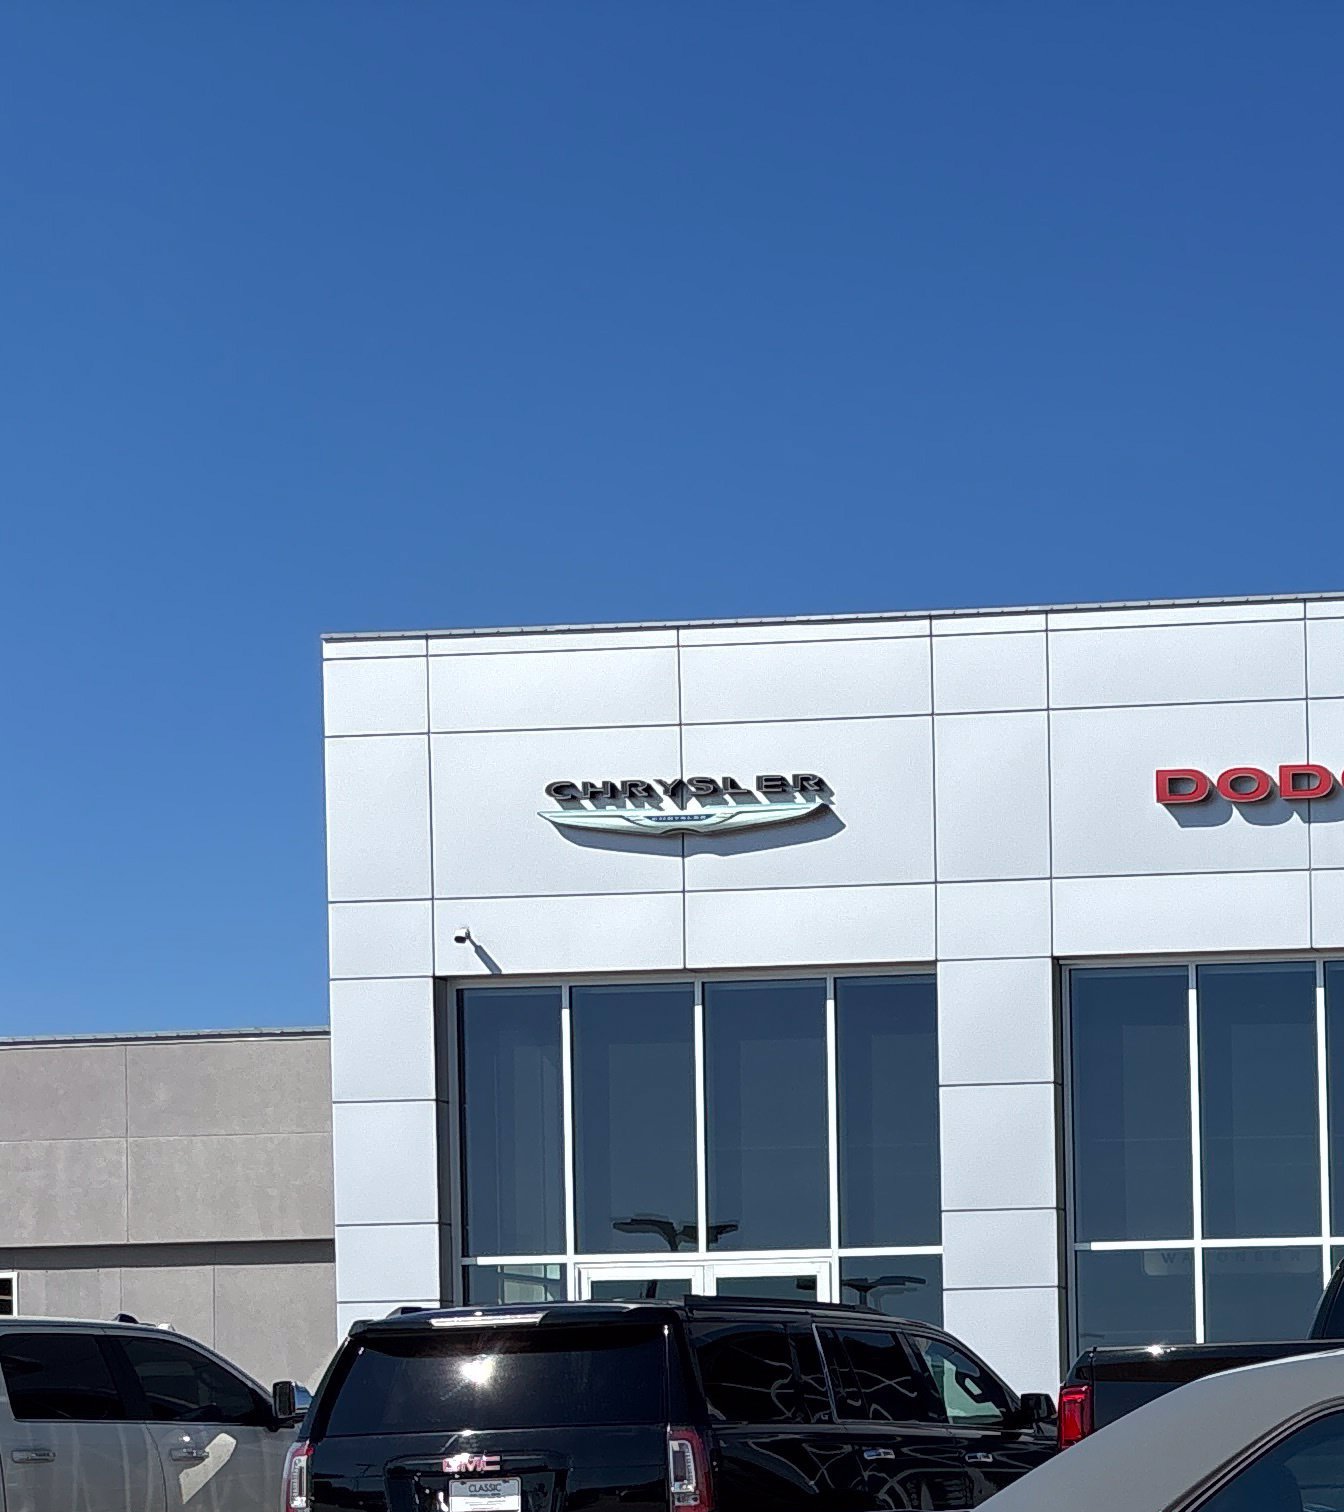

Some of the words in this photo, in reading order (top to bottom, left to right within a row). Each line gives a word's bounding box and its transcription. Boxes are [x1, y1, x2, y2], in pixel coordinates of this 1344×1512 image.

[545, 773, 826, 800] CHRYSLER
[1160, 1250, 1301, 1264] WAONEER
[468, 1483, 502, 1494] CLASSIC
